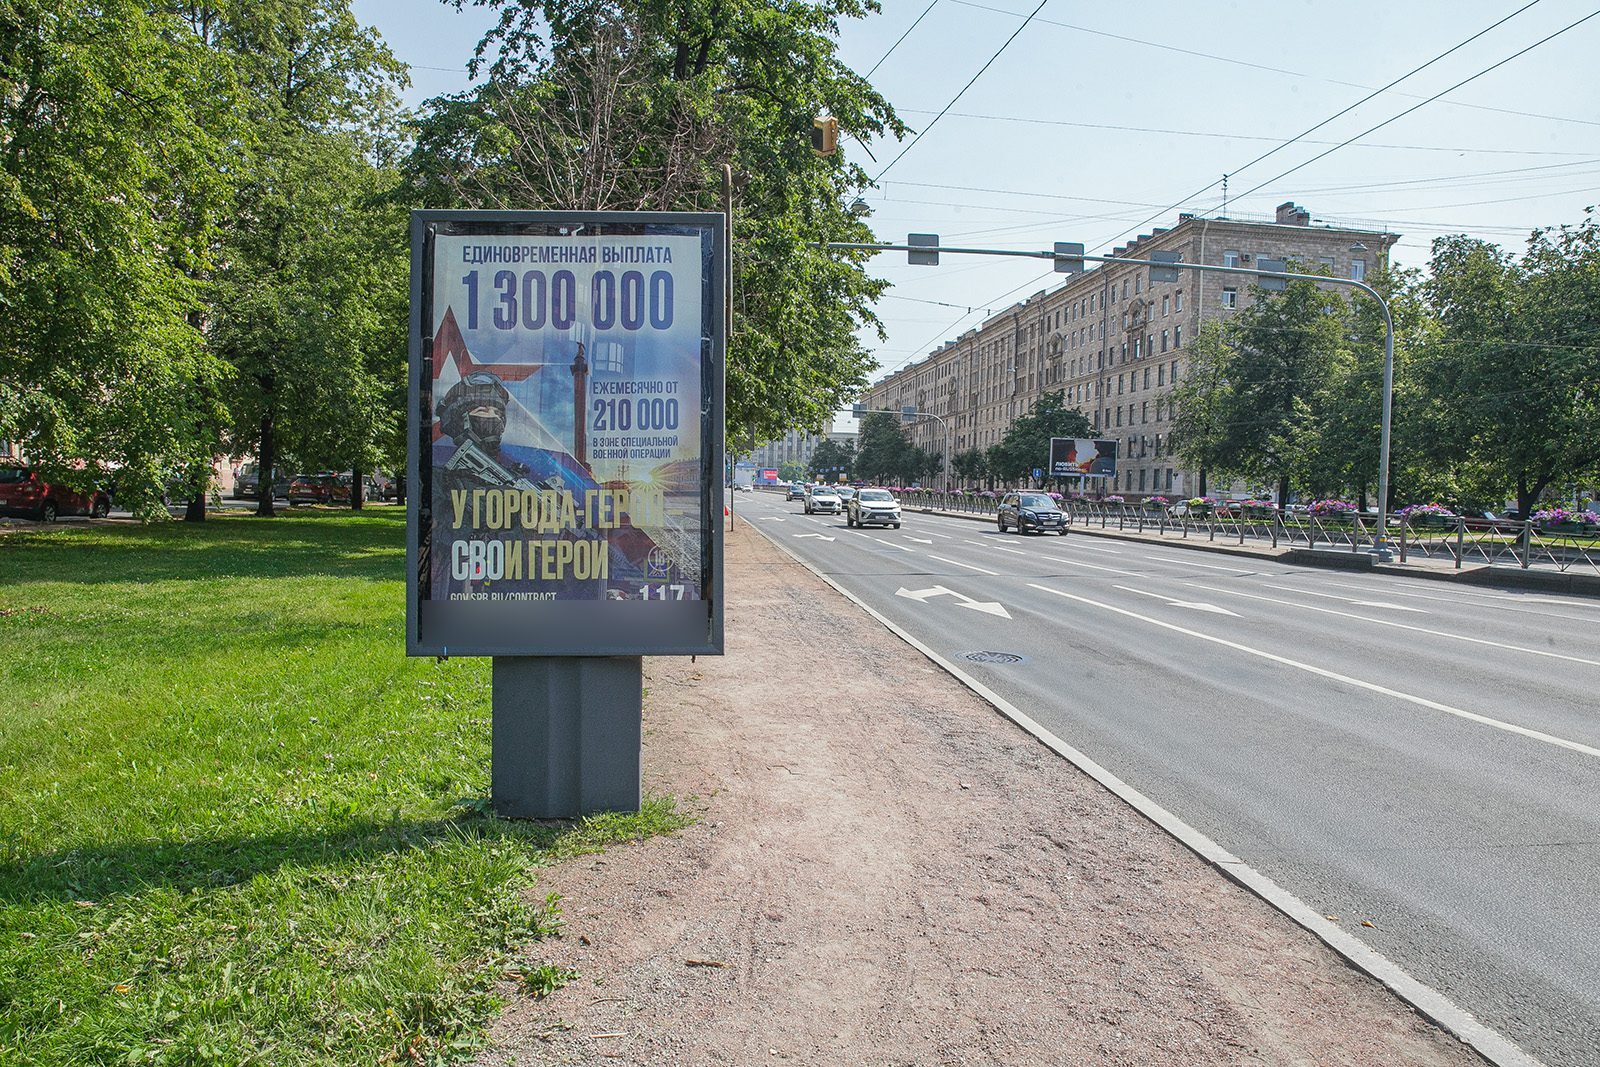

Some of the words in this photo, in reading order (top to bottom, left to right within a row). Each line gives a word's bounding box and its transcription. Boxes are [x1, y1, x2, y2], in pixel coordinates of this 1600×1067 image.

[462, 246, 597, 264] ЕДИНОВРЕМЕННАЯ
[602, 246, 673, 263] ВЫПЛАТА
[462, 270, 478, 330] 1
[493, 269, 577, 330] 300
[591, 269, 674, 330] 000
[593, 381, 663, 394] ЕЖЕМЕСЯЧНО
[665, 381, 679, 394] ОТ
[593, 398, 632, 431] 210
[637, 398, 679, 431] 000
[593, 437, 598, 447] В
[599, 437, 619, 447] ЗОНЕ
[621, 435, 678, 448] СПЕЦИАЛЬНОЙ
[593, 447, 629, 459] ВОЕННОЙ
[630, 448, 671, 459] ОПЕРАЦИИ
[451, 489, 468, 529] У
[451, 540, 522, 581] СВОИ
[528, 540, 609, 580] ГЕРОИ
